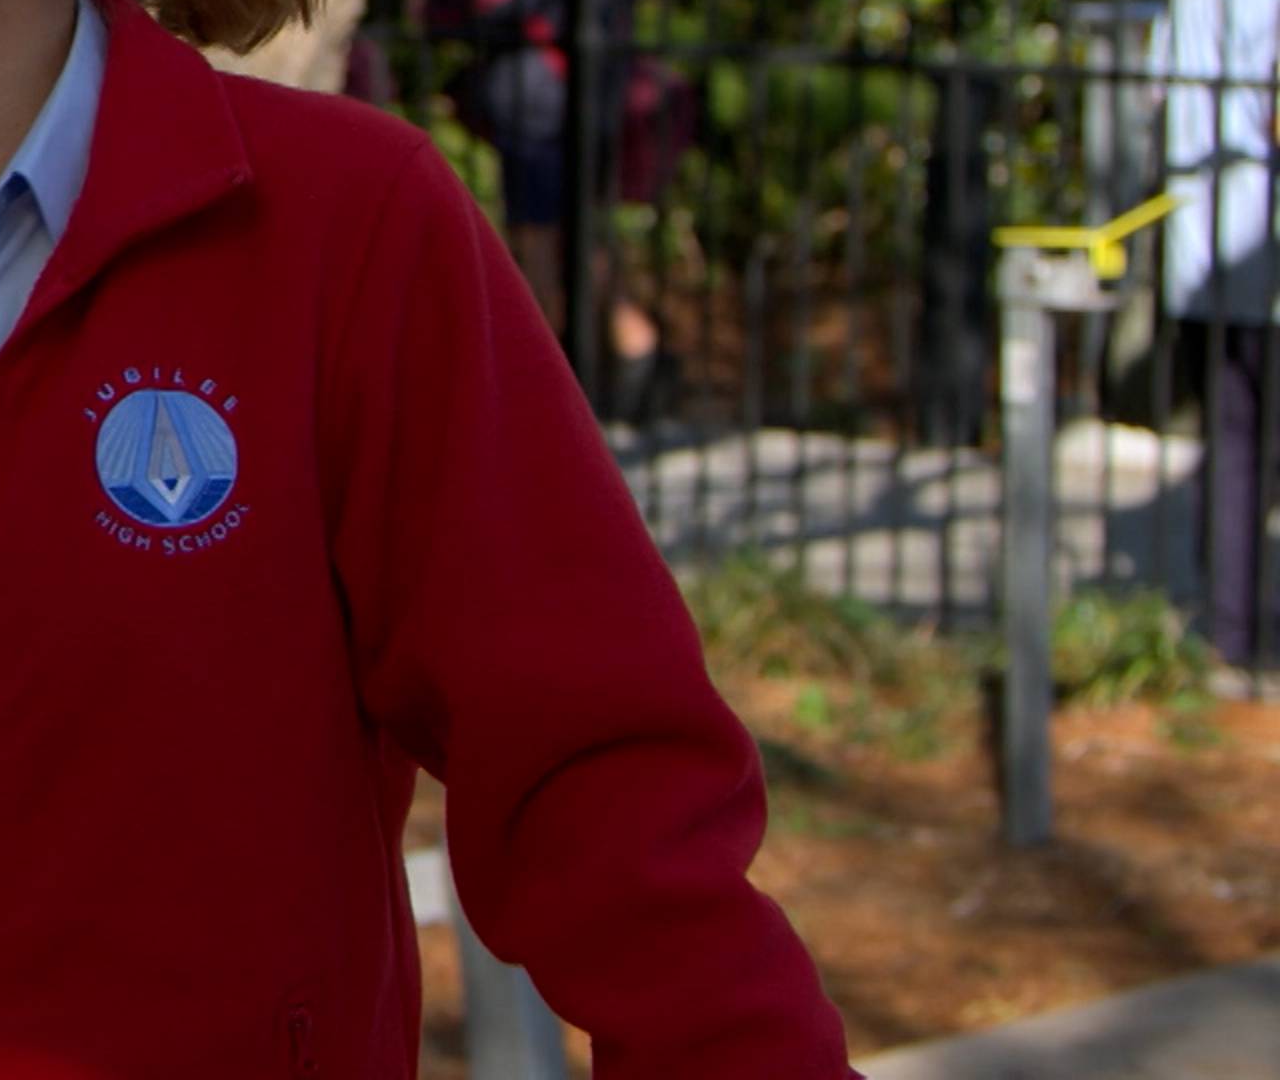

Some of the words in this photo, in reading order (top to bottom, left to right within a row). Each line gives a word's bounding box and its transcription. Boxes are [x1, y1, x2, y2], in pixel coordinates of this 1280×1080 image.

[84, 367, 238, 422] JUBILEE
[96, 510, 151, 551] HIGH
[162, 504, 249, 554] SCHOOL
